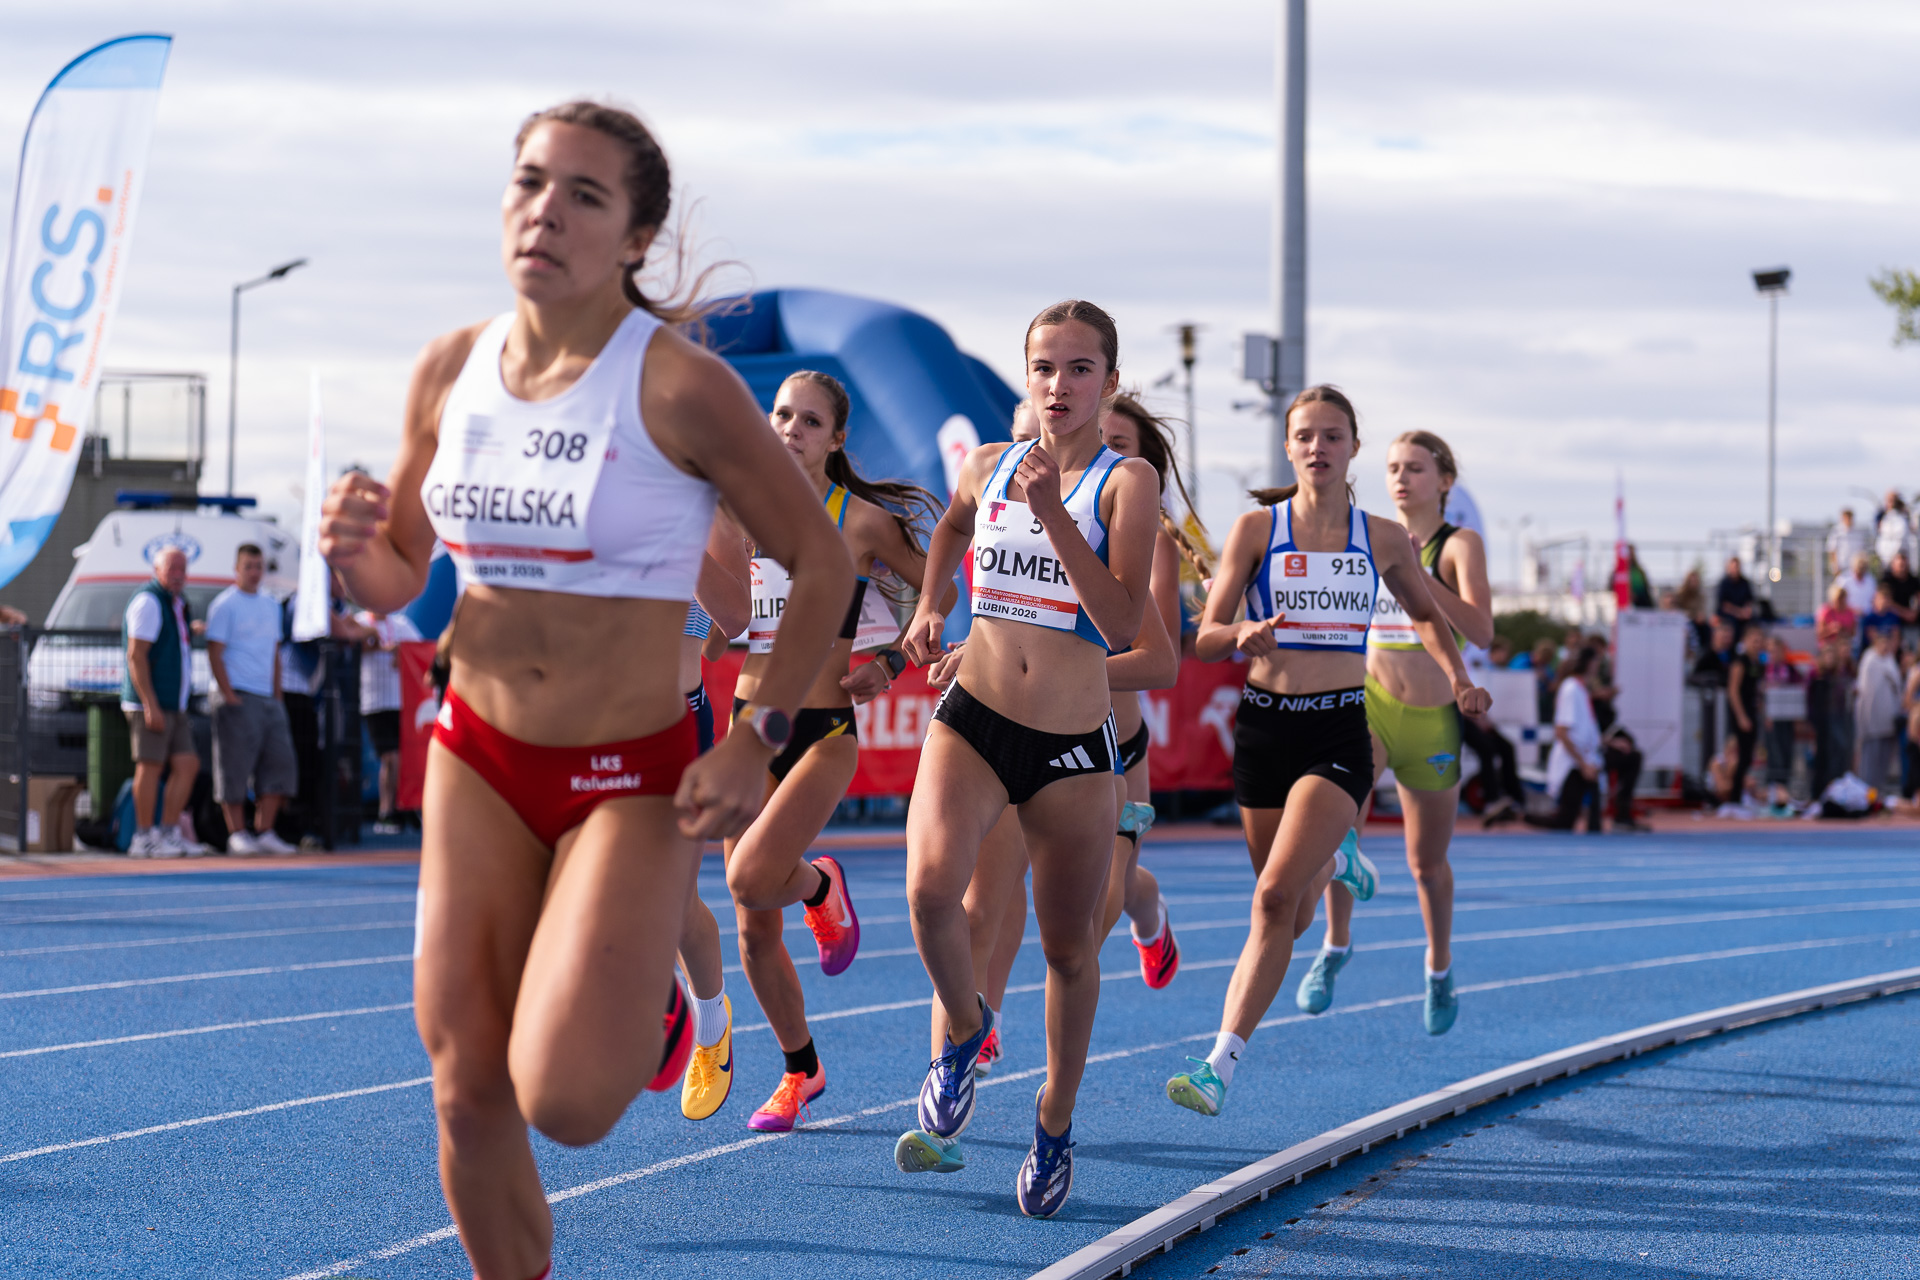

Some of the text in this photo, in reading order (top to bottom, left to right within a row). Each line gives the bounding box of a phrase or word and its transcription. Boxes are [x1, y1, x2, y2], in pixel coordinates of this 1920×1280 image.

[523, 429, 588, 462] 308
[428, 484, 577, 528] CIESIELSKA
[1331, 558, 1367, 576] 915
[1275, 586, 1369, 612] PUSTÓWKA
[977, 601, 1038, 619] LUBIN 2026
[1302, 632, 1348, 641] LUBIN 2026
[1278, 694, 1337, 712] NIKE
[590, 754, 622, 772] LKS
